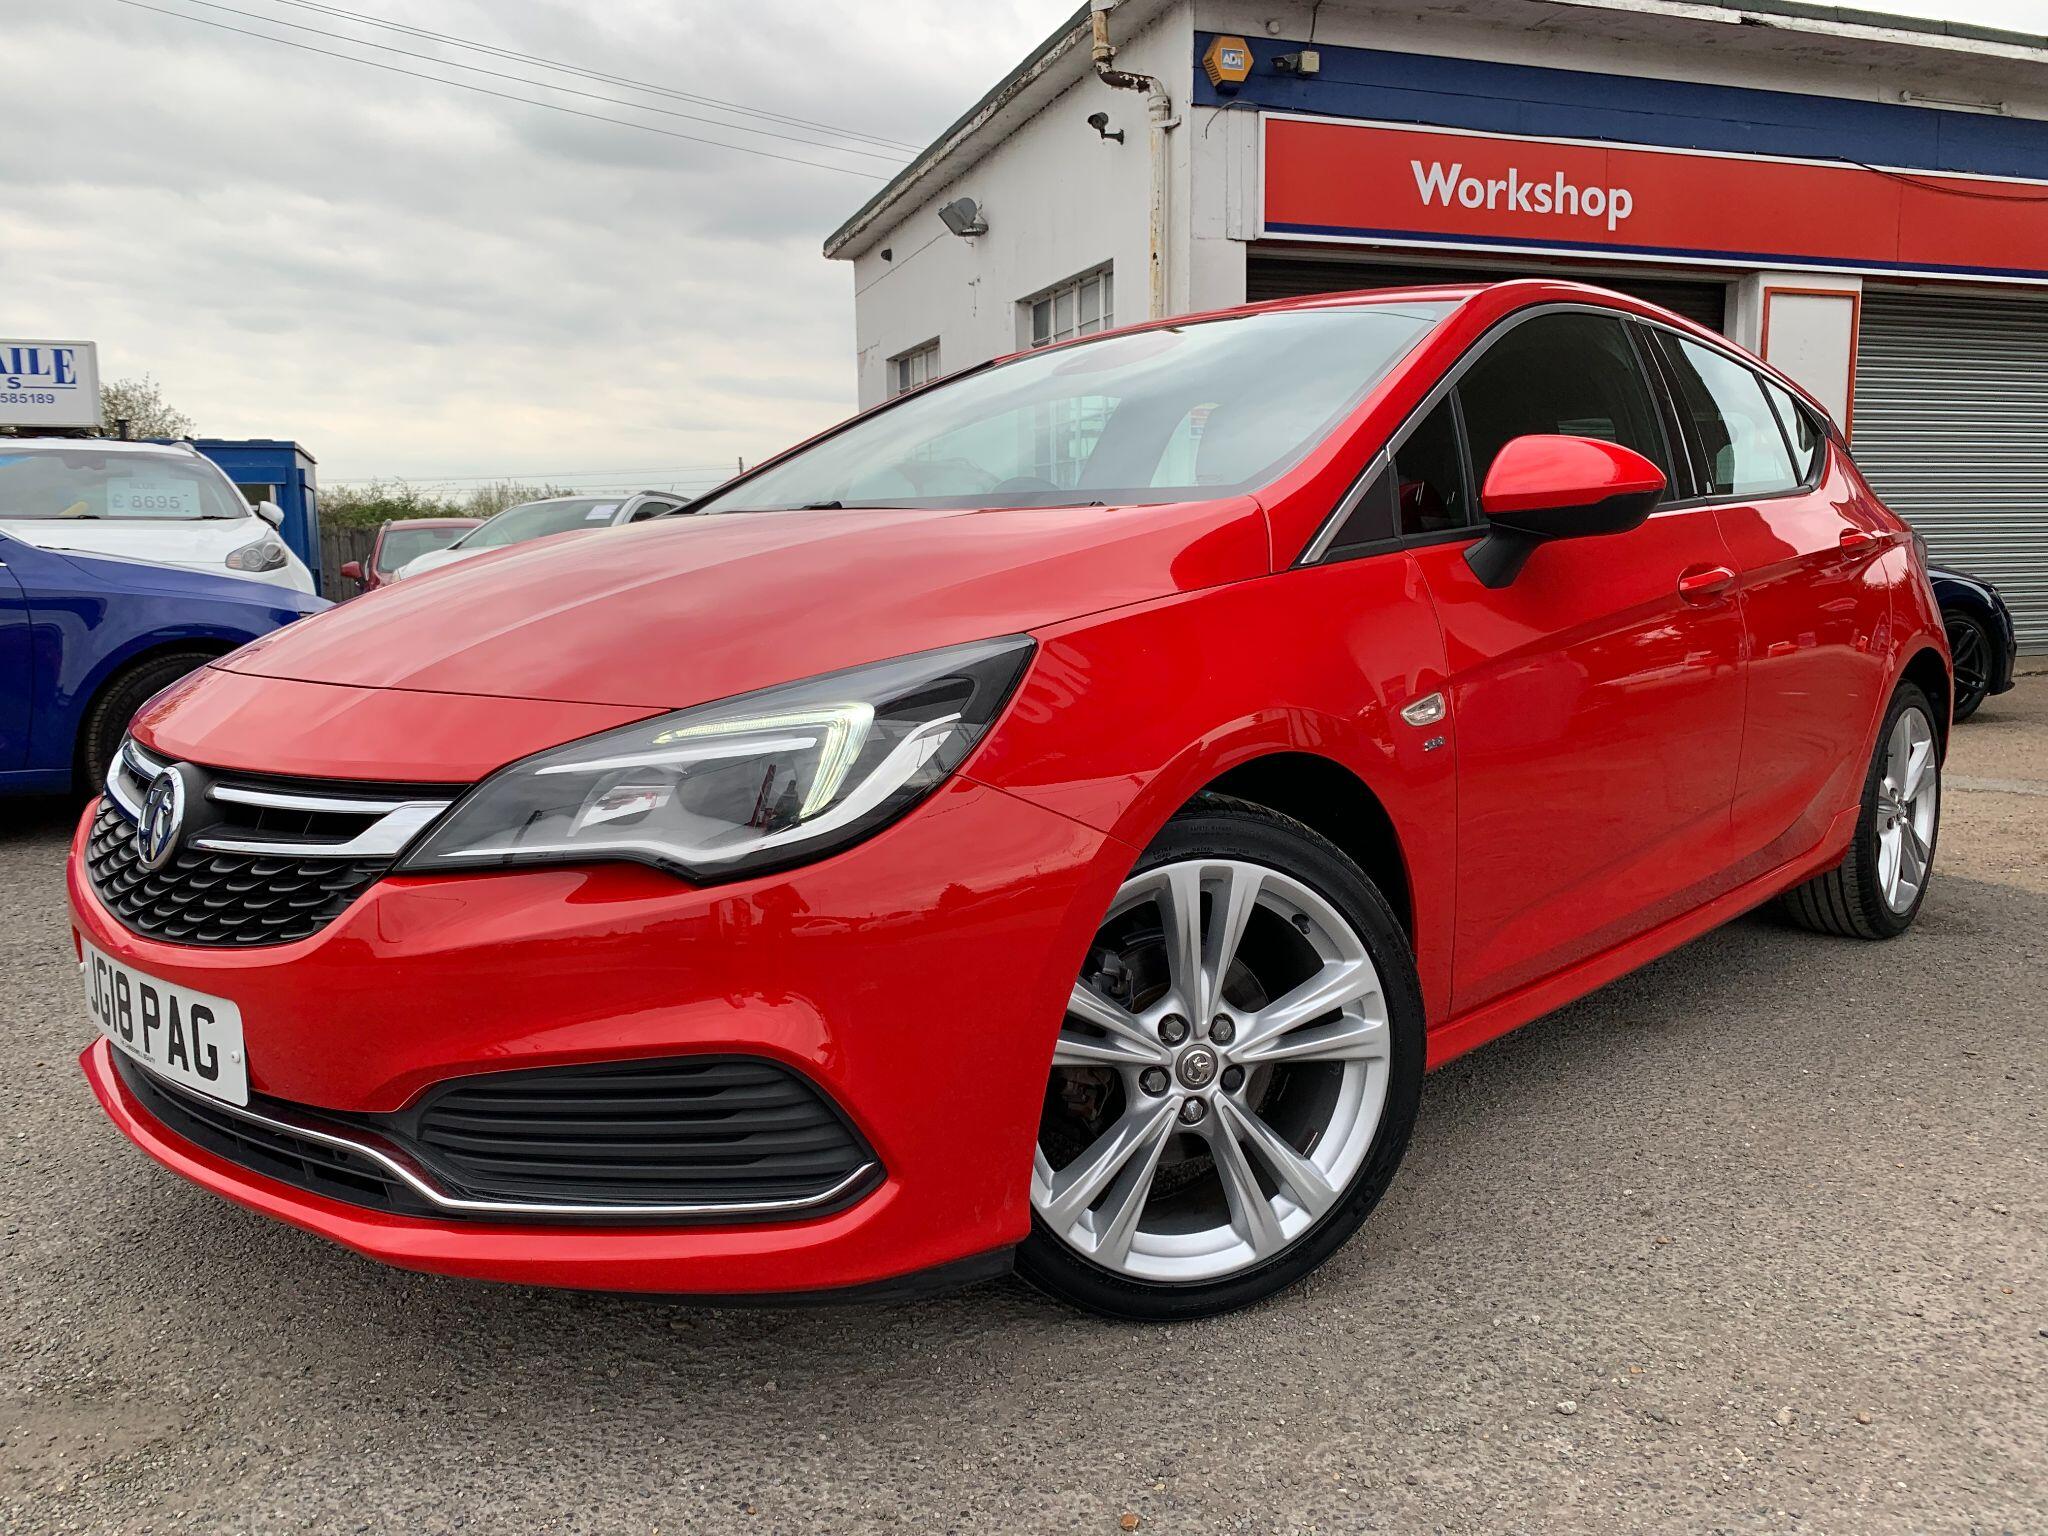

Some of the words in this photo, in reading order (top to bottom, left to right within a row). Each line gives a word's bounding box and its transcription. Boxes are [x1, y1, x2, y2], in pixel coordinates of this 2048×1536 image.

[1410, 160, 1634, 232] Workshop
[0, 347, 77, 385] ILE
[0, 393, 56, 404] 585189
[131, 495, 180, 509] 8695
[90, 950, 134, 1044] JG18
[139, 982, 219, 1082] PAG
